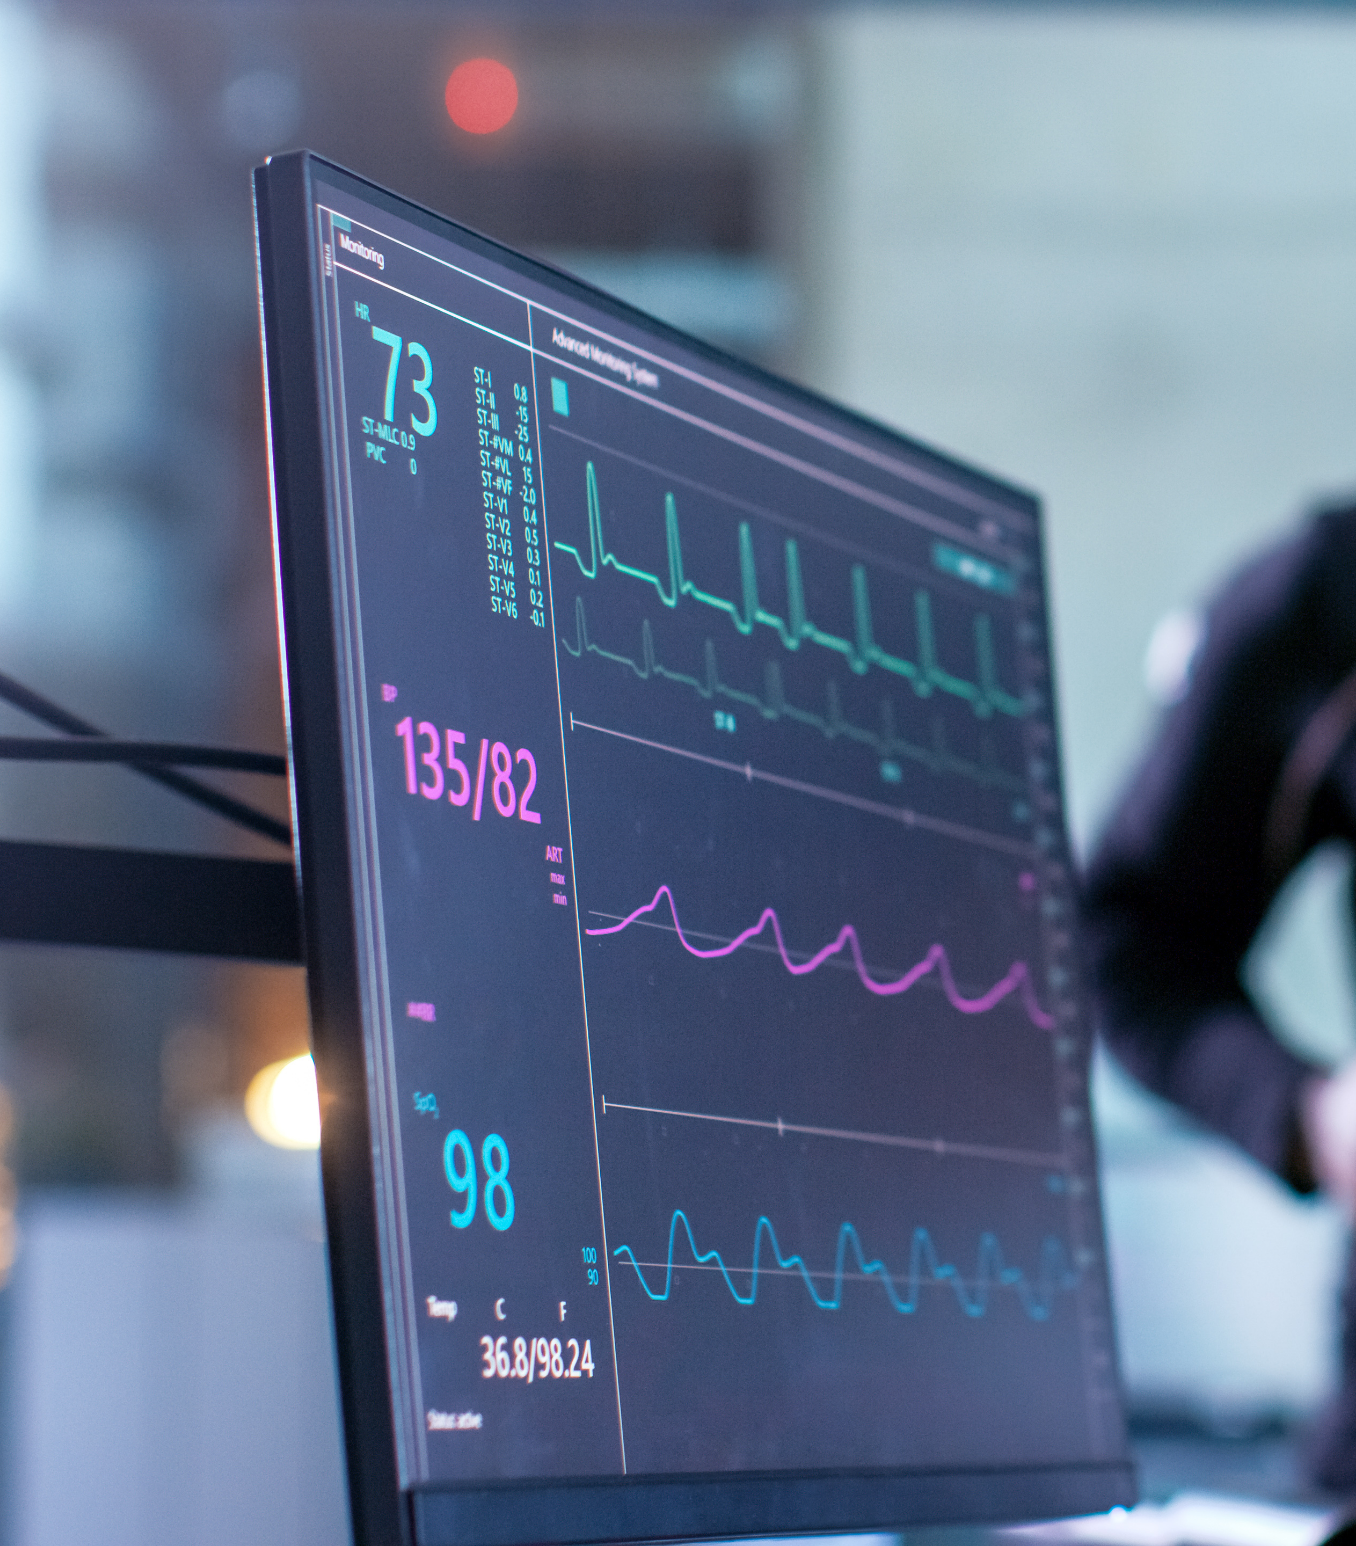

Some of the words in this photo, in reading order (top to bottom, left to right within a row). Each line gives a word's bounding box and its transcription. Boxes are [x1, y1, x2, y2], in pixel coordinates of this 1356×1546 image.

[340, 232, 385, 270] Monitoring
[355, 300, 370, 322] HR
[552, 327, 590, 359] Advanced
[591, 344, 631, 382] Monitoring
[371, 325, 438, 437] 73
[474, 366, 491, 388] ST-I
[514, 383, 528, 404] 0.8
[476, 387, 495, 410] ST-II
[516, 405, 528, 424] -15
[362, 416, 399, 446] ST-MLC
[401, 430, 416, 451] 0.9
[477, 408, 499, 431] ST-III
[515, 424, 529, 443] -25
[366, 441, 387, 464] PVC
[410, 458, 417, 475] 0
[479, 429, 513, 457] ST-#VM
[518, 444, 533, 464] 0.4
[480, 449, 512, 476] ST-#VL
[523, 466, 533, 484] 15
[482, 470, 512, 496] ST-#VF
[520, 485, 536, 505] -2.0
[483, 491, 508, 515] ST-V1
[523, 506, 537, 525] 0.4
[485, 512, 511, 537] ST-V2
[525, 526, 539, 546] 0.5
[486, 532, 512, 556] ST-V3
[527, 547, 540, 566] 0.3
[488, 554, 515, 578] ST-V4
[528, 568, 540, 587] 0.1
[490, 574, 516, 598] ST-V5
[530, 588, 544, 608] 0.2
[491, 595, 518, 619] ST-V6
[530, 609, 545, 628] -0.1
[395, 716, 542, 824] 135/82
[545, 845, 563, 863] ART
[550, 872, 565, 885] max
[553, 891, 567, 906] min
[443, 1128, 515, 1231] 98
[582, 1247, 597, 1264] 100
[587, 1268, 599, 1286] 90
[494, 1298, 506, 1321] C
[559, 1301, 567, 1322] F
[480, 1334, 595, 1384] 36.8/98.24
